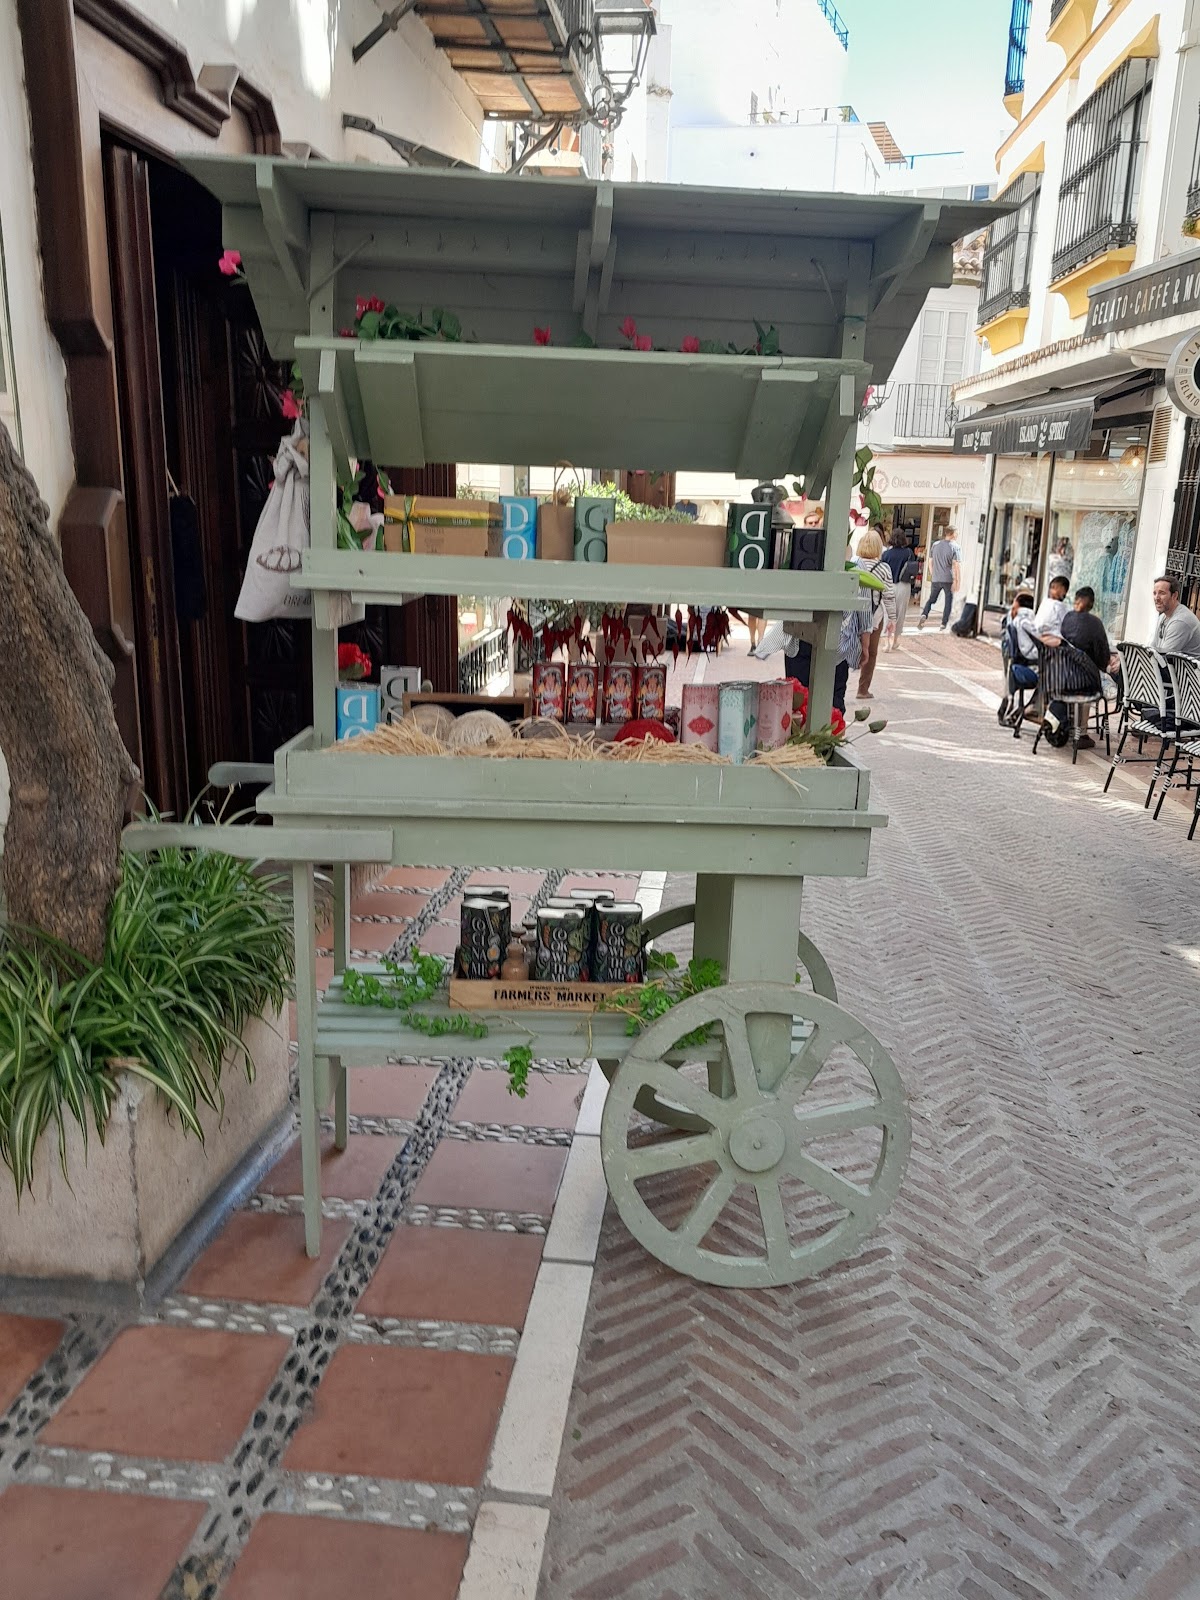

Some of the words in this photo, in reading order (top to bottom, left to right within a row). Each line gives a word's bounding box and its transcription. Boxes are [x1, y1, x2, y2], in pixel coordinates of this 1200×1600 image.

[1091, 294, 1129, 327] GELATO
[1134, 277, 1170, 315] CAFFÉ
[1172, 278, 1181, 305] &
[1179, 379, 1199, 407] GELATO
[1019, 424, 1038, 443] ISLAND
[1048, 420, 1070, 442] SPIRIT
[494, 989, 550, 1002] FARMERS
[557, 990, 606, 1003] MARKET
